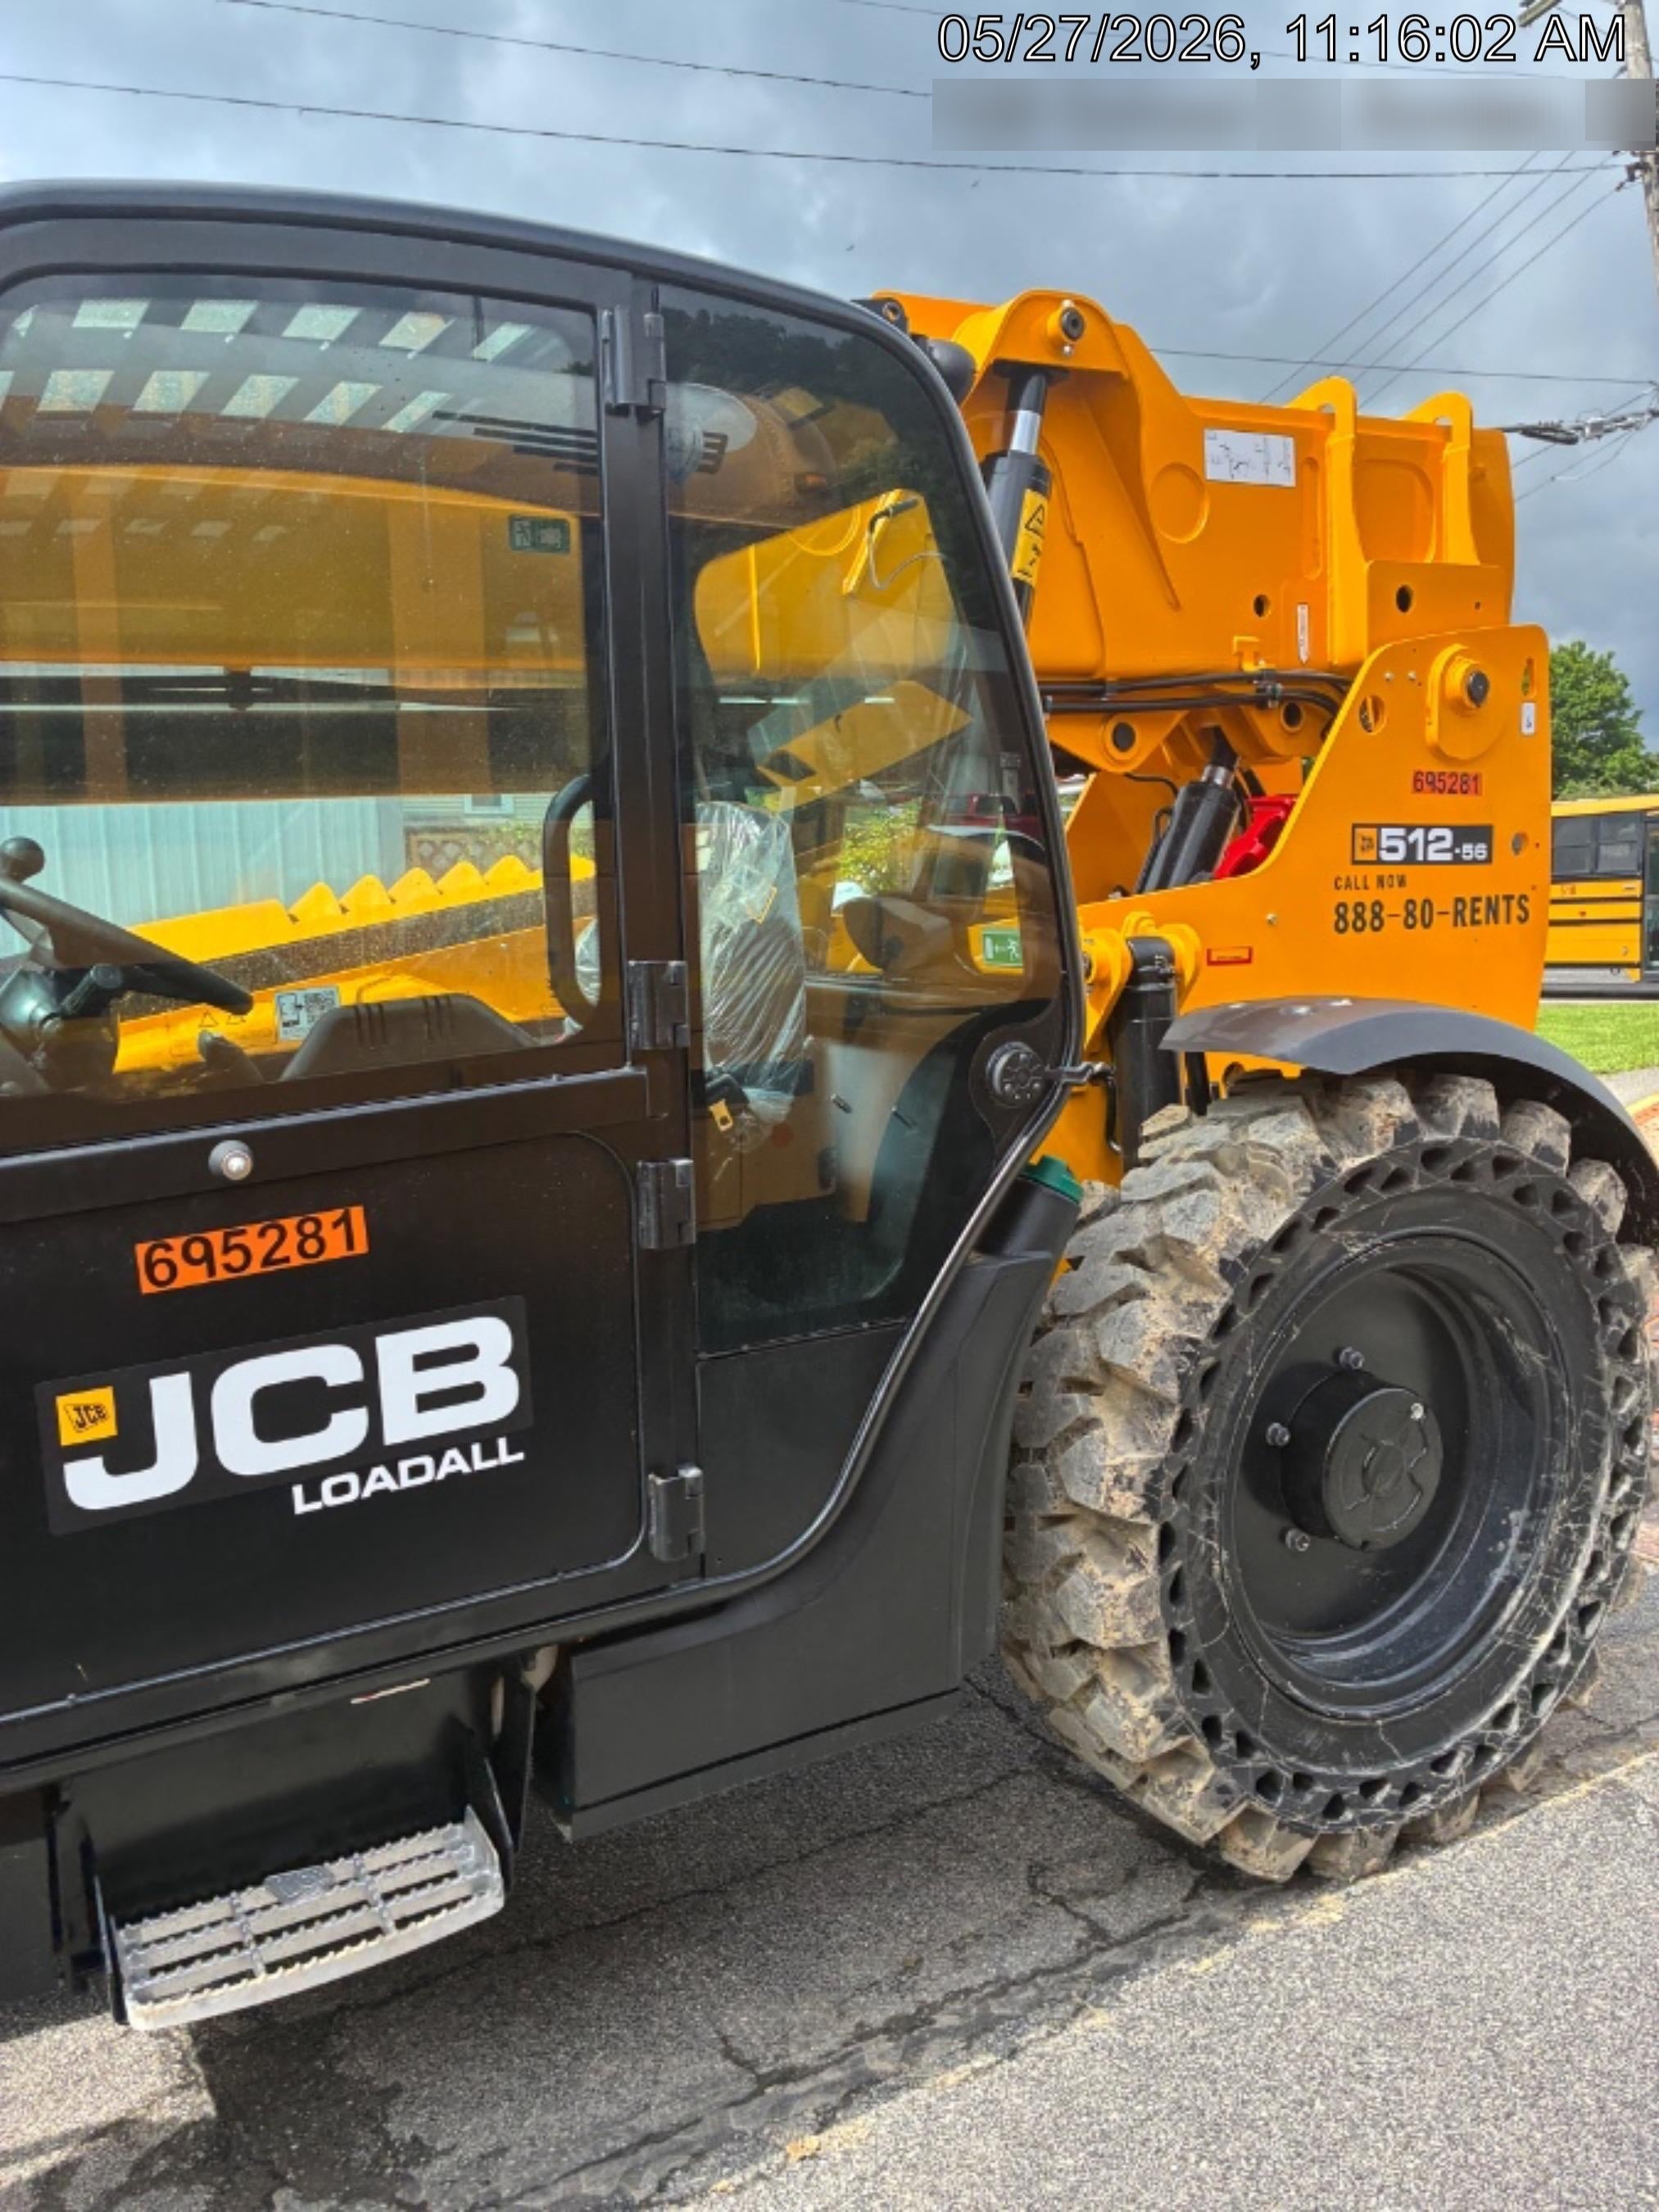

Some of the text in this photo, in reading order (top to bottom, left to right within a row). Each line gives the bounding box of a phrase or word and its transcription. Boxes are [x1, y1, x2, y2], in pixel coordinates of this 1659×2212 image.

[1413, 769, 1480, 795] 695281
[1334, 874, 1407, 891] CALL NOW
[1334, 895, 1530, 935] 888-80-RENTS
[144, 1208, 356, 1289] 695281
[63, 1316, 520, 1511] JCB
[292, 1436, 524, 1515] LOADALL
